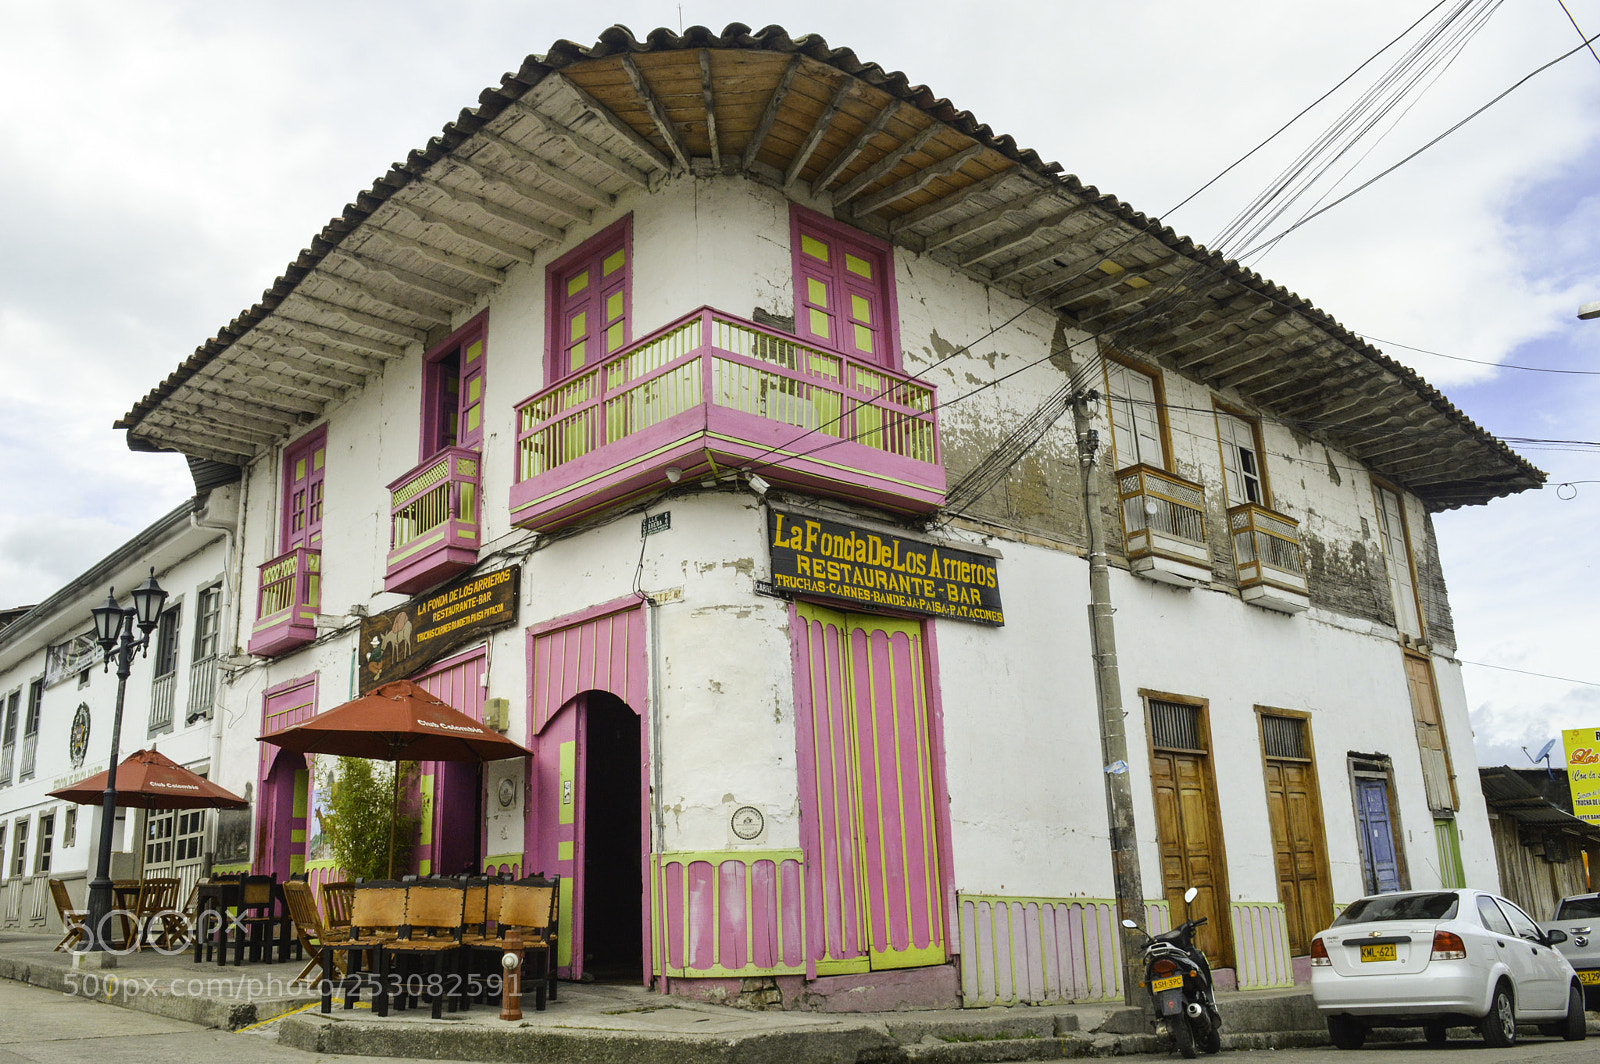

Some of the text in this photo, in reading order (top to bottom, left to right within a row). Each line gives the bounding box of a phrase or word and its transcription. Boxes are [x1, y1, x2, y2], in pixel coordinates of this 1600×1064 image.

[773, 513, 996, 588] La Fonda De Los Arrieros
[417, 569, 510, 616] LA FONDA DE LOS ARRIEROS
[417, 719, 484, 734] Club Colombia
[166, 782, 200, 790] Colombia
